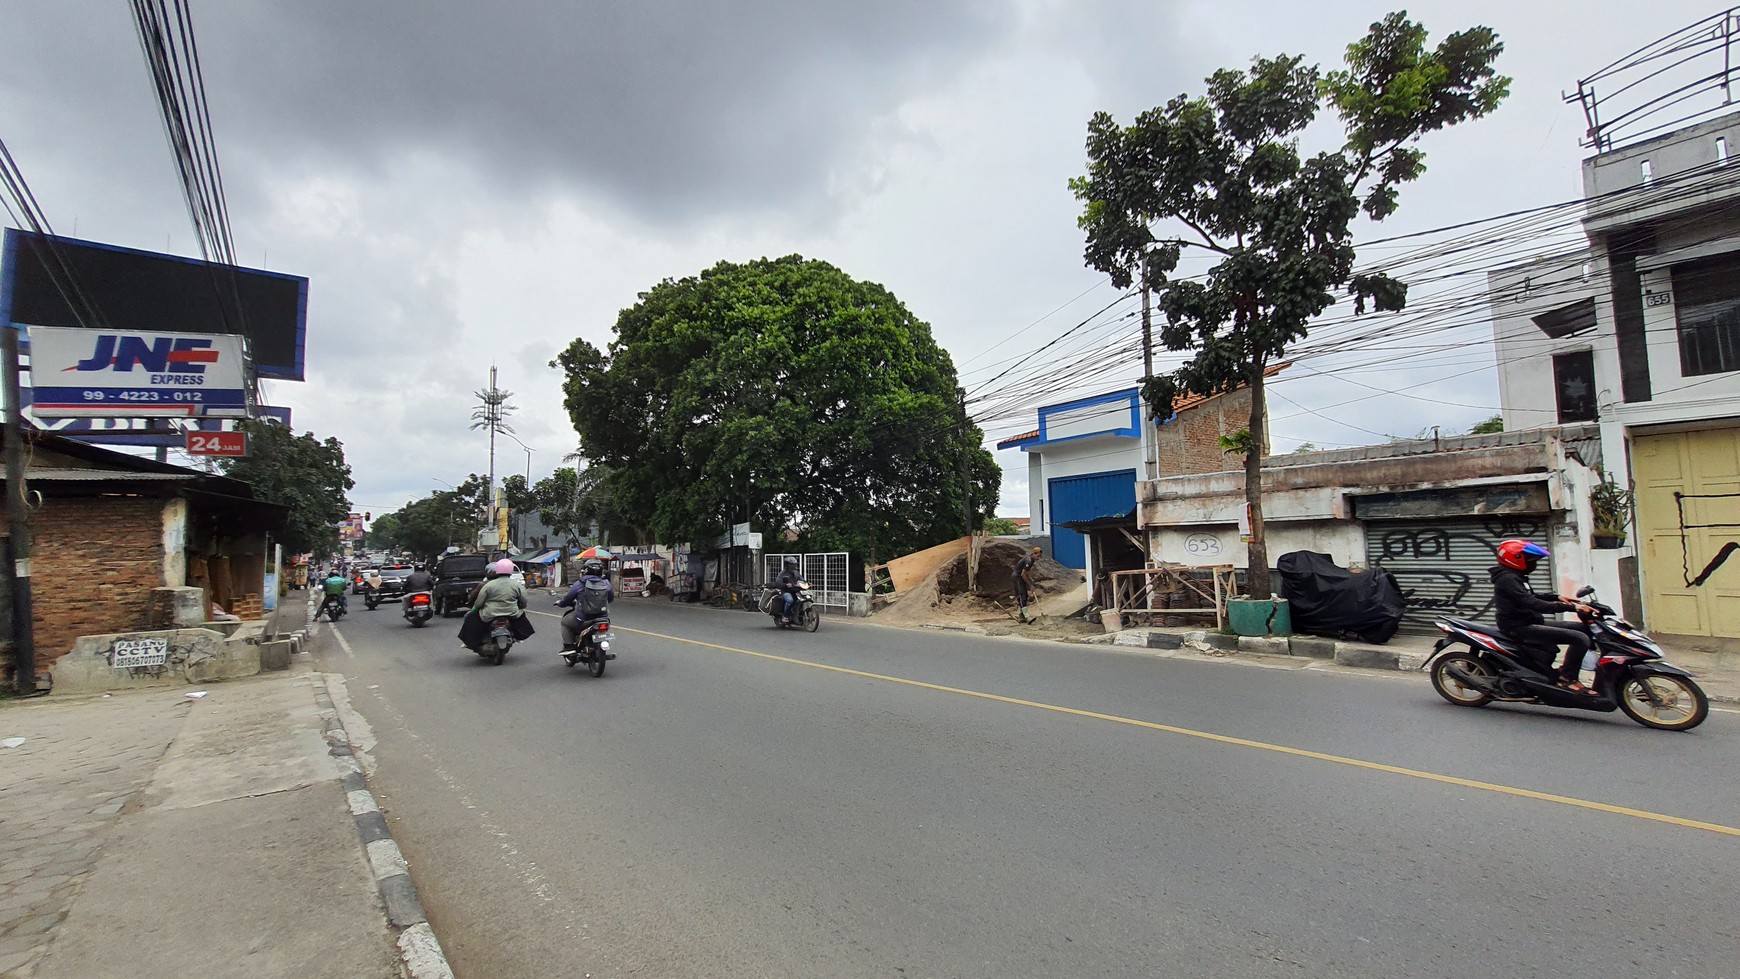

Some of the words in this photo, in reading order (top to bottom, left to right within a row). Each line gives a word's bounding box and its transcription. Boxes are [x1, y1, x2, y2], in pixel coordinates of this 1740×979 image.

[1647, 294, 1669, 306] 655
[76, 335, 219, 374] JNE
[150, 374, 204, 385] EXPRESS
[83, 390, 104, 400] 99
[119, 391, 159, 401] 4223
[173, 391, 202, 401] 012
[190, 437, 222, 451] 24
[1188, 538, 1219, 553] 653
[116, 646, 165, 656] CCTV
